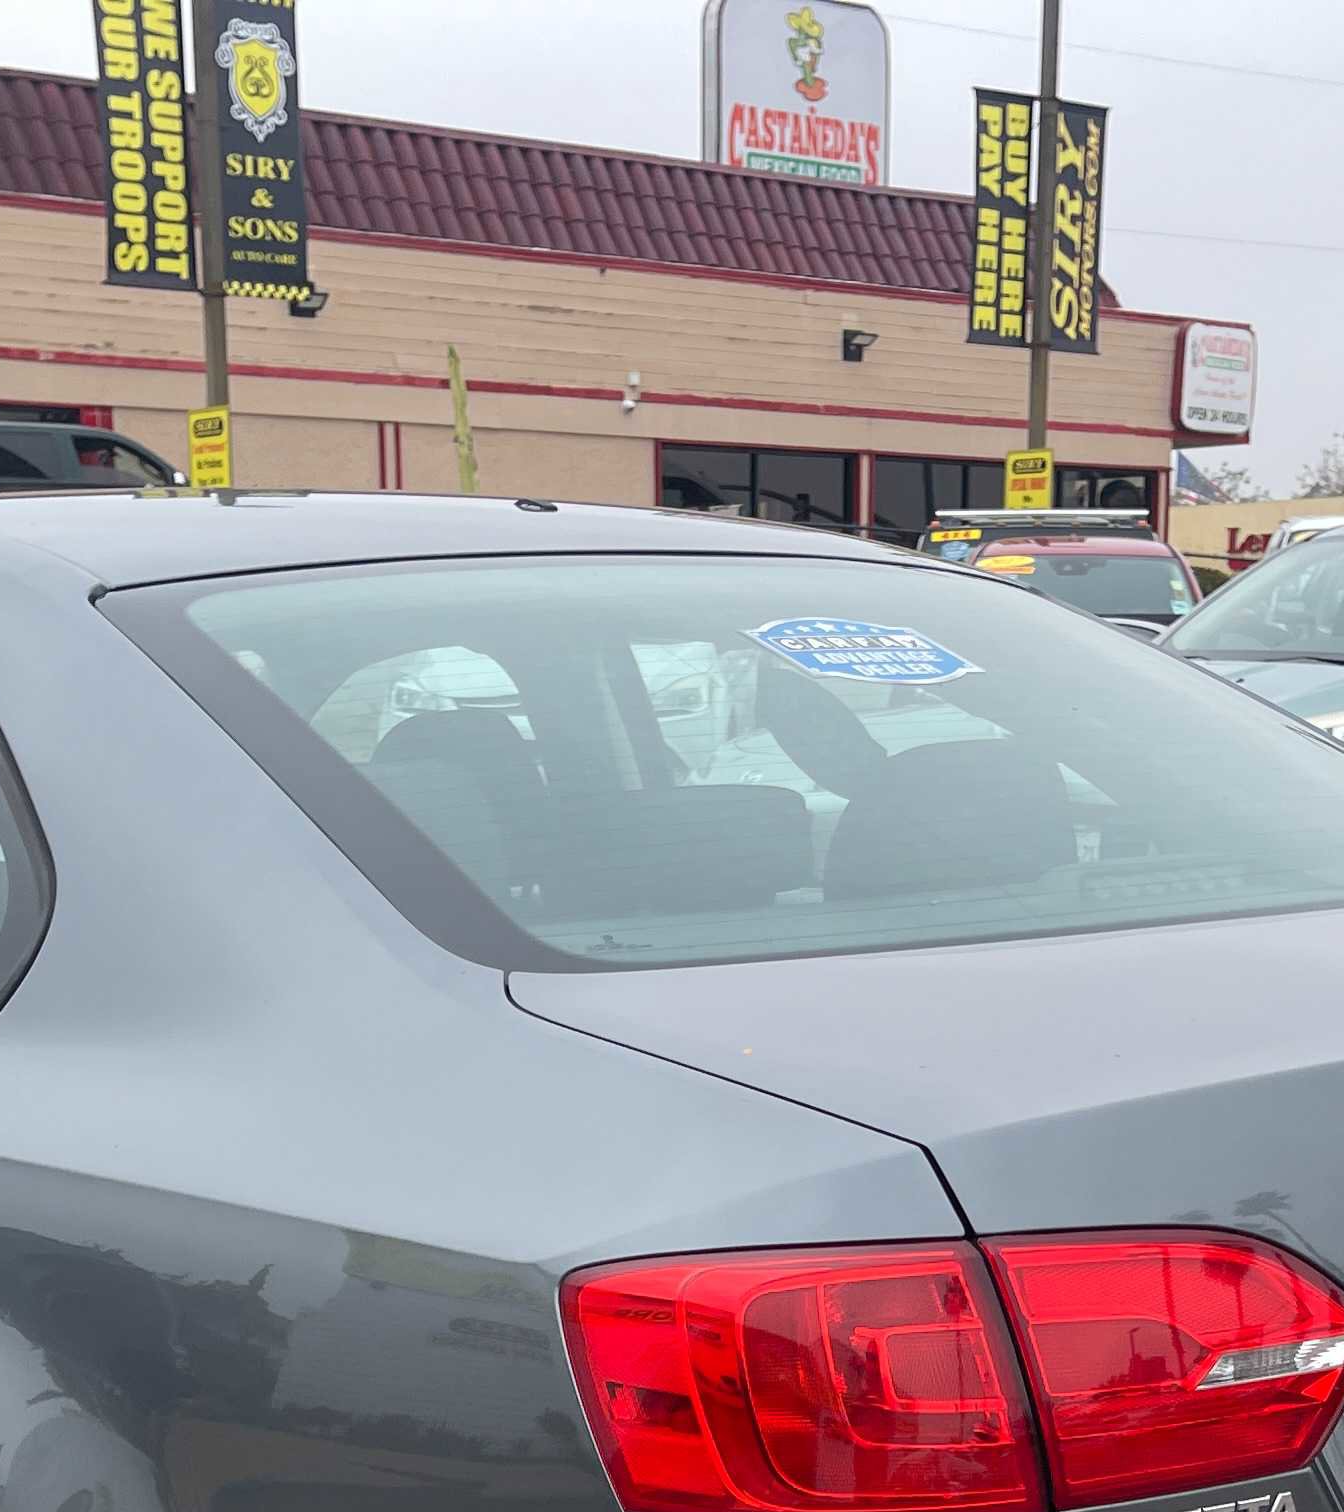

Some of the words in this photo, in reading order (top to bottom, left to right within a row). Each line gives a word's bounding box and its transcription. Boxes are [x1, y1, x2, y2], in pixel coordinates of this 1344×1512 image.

[107, 90, 150, 273] TROOPS
[145, 69, 190, 280] SUPPORT
[226, 153, 296, 182] SIRY
[250, 187, 274, 209] &
[979, 104, 1003, 199] PAY
[1003, 103, 1030, 207] BUY
[228, 215, 300, 244] SONS
[972, 207, 1001, 331] HERE
[1050, 112, 1085, 341] SIRY
[998, 217, 1026, 337] HERE
[778, 634, 932, 651] CARFAX
[813, 650, 944, 666] ADVANTAGE
[852, 662, 944, 677] DEALER
